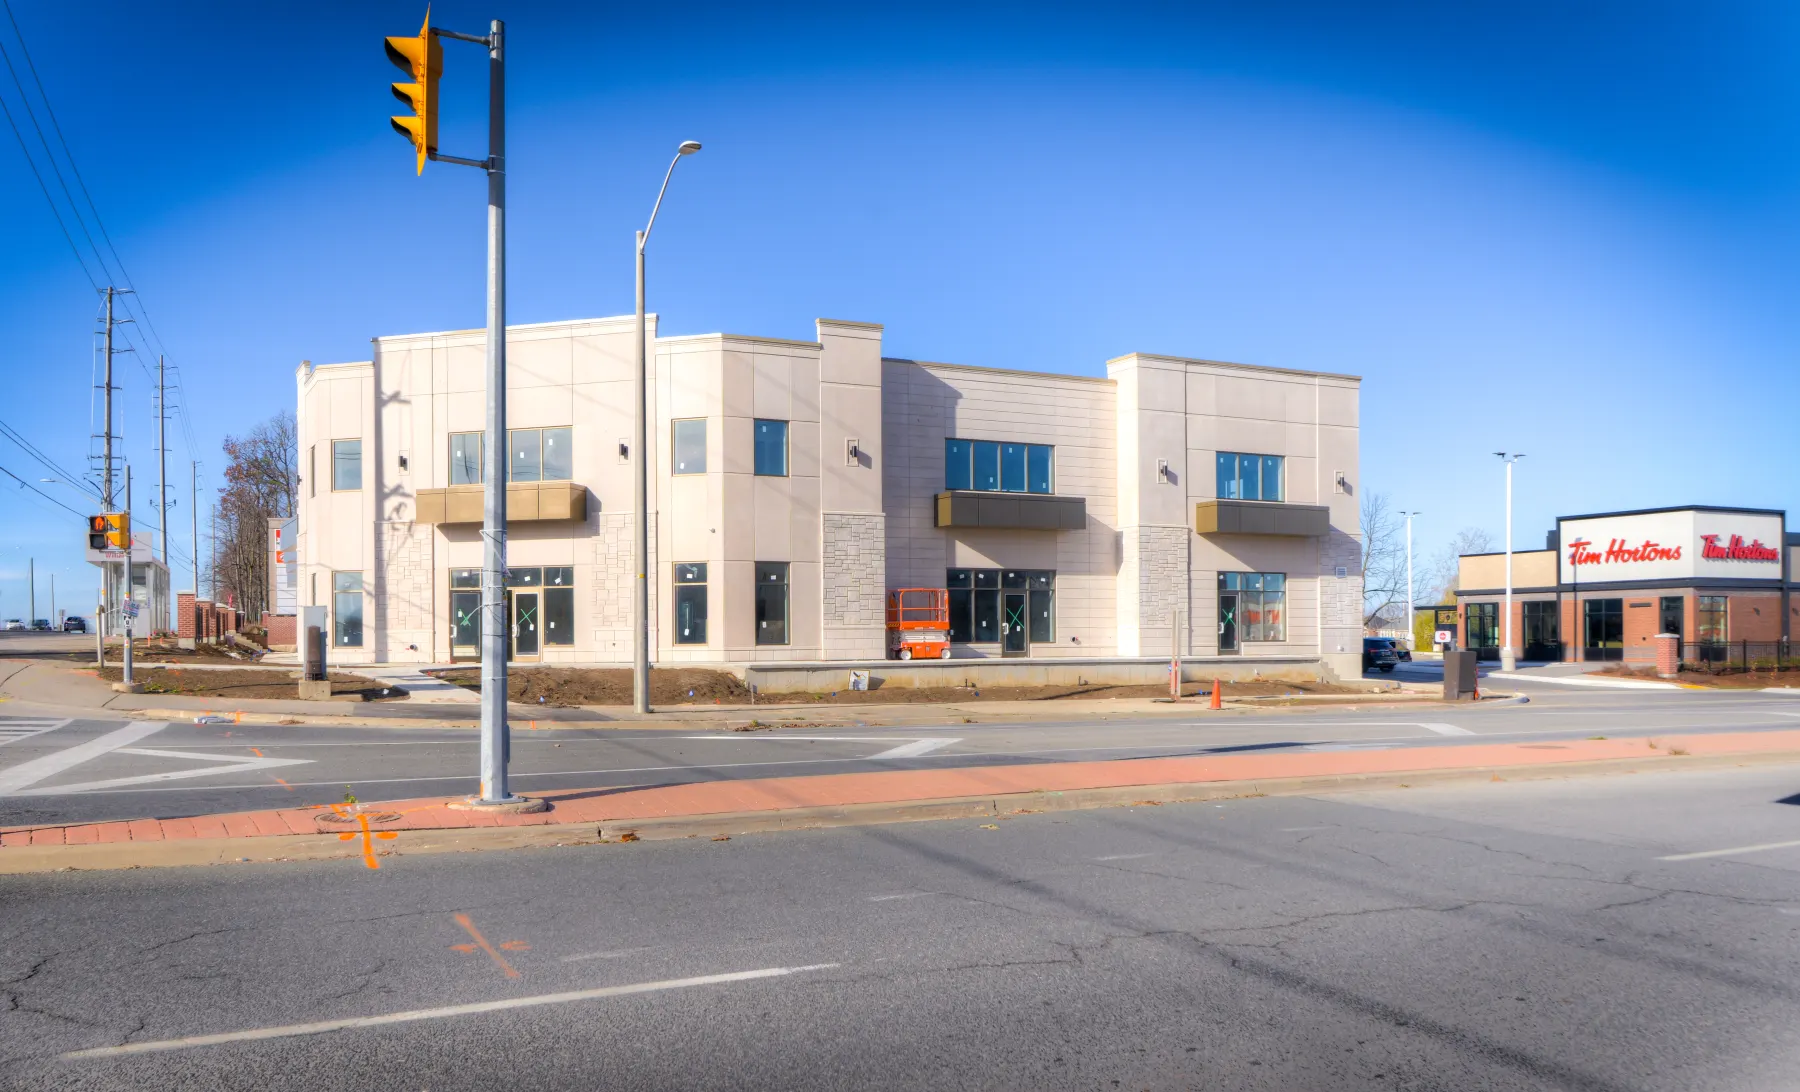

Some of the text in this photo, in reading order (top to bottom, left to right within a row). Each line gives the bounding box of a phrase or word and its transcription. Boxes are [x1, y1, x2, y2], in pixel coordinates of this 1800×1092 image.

[1568, 538, 1682, 566] Tim Hortons
[1700, 534, 1778, 560] Tim Hortons
